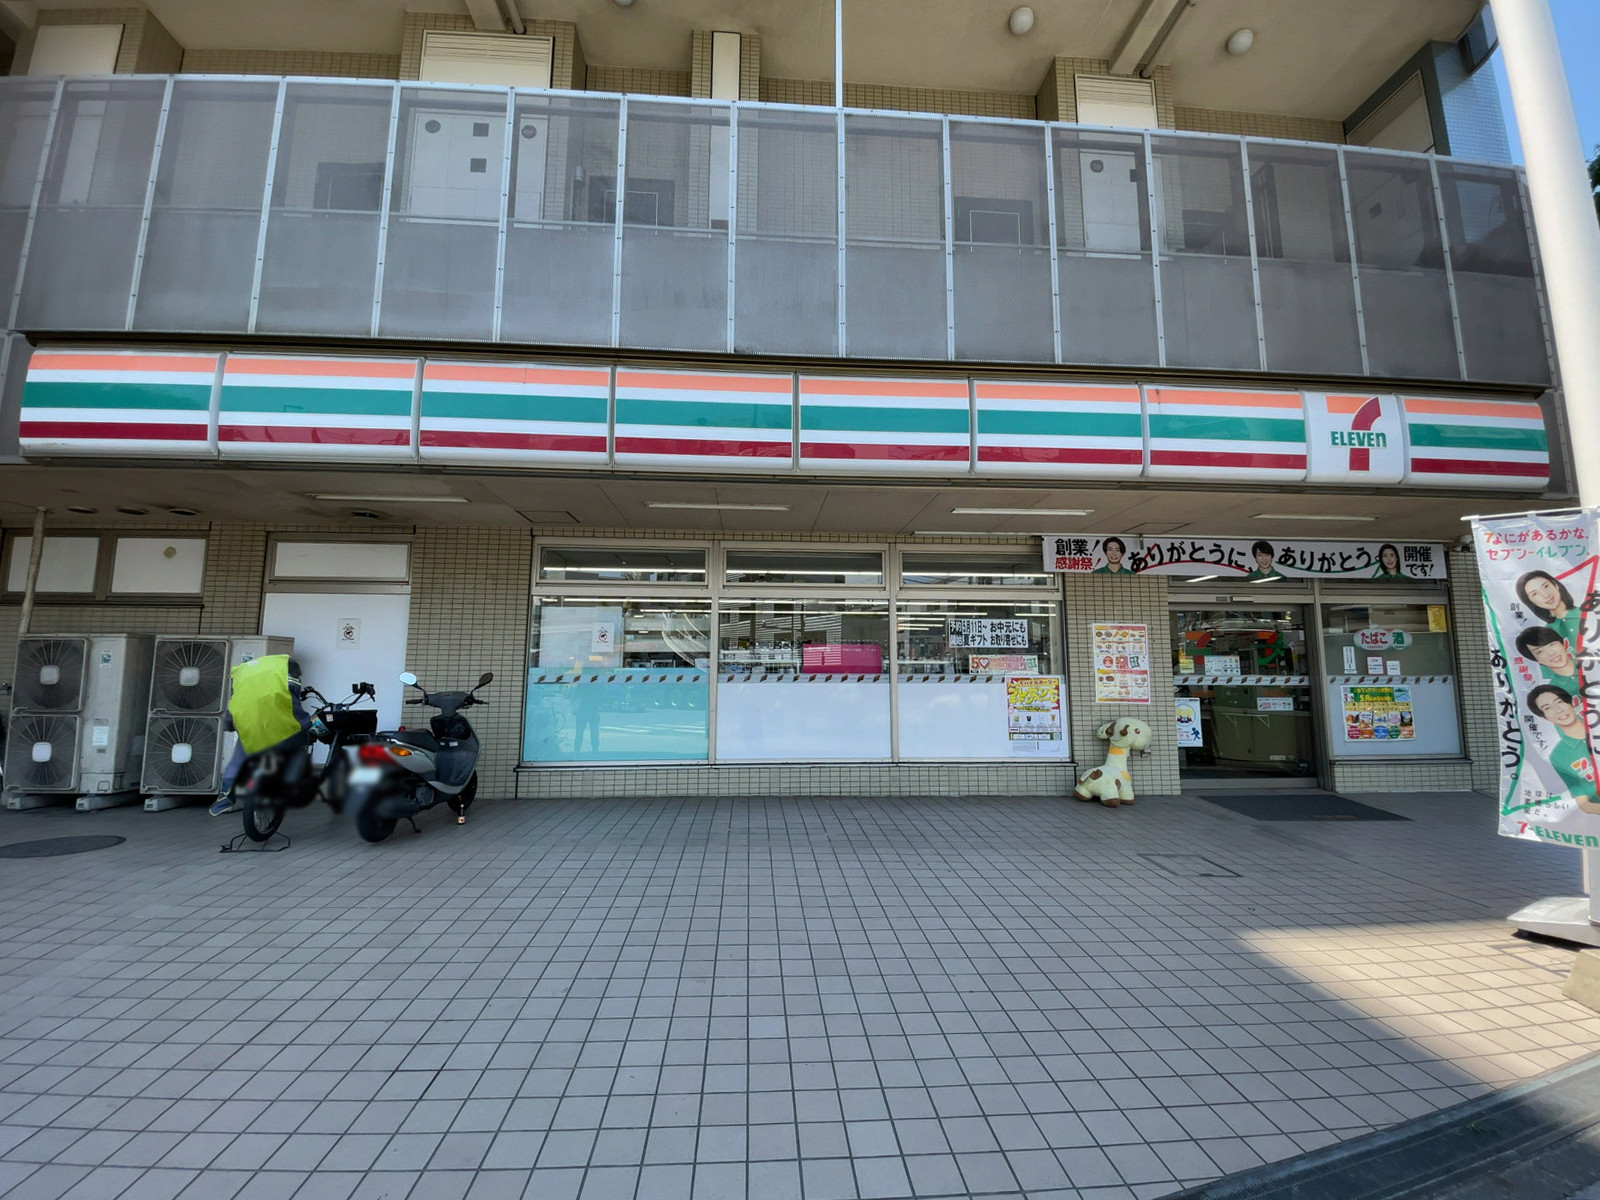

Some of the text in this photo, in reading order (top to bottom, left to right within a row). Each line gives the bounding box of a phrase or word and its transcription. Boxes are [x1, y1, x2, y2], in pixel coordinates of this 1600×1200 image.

[1055, 538, 1101, 557] 創業!
[1404, 546, 1432, 562] 開催
[1055, 557, 1101, 570] 感謝祭!
[1405, 563, 1434, 577] です!
[1361, 632, 1388, 645] たばこ
